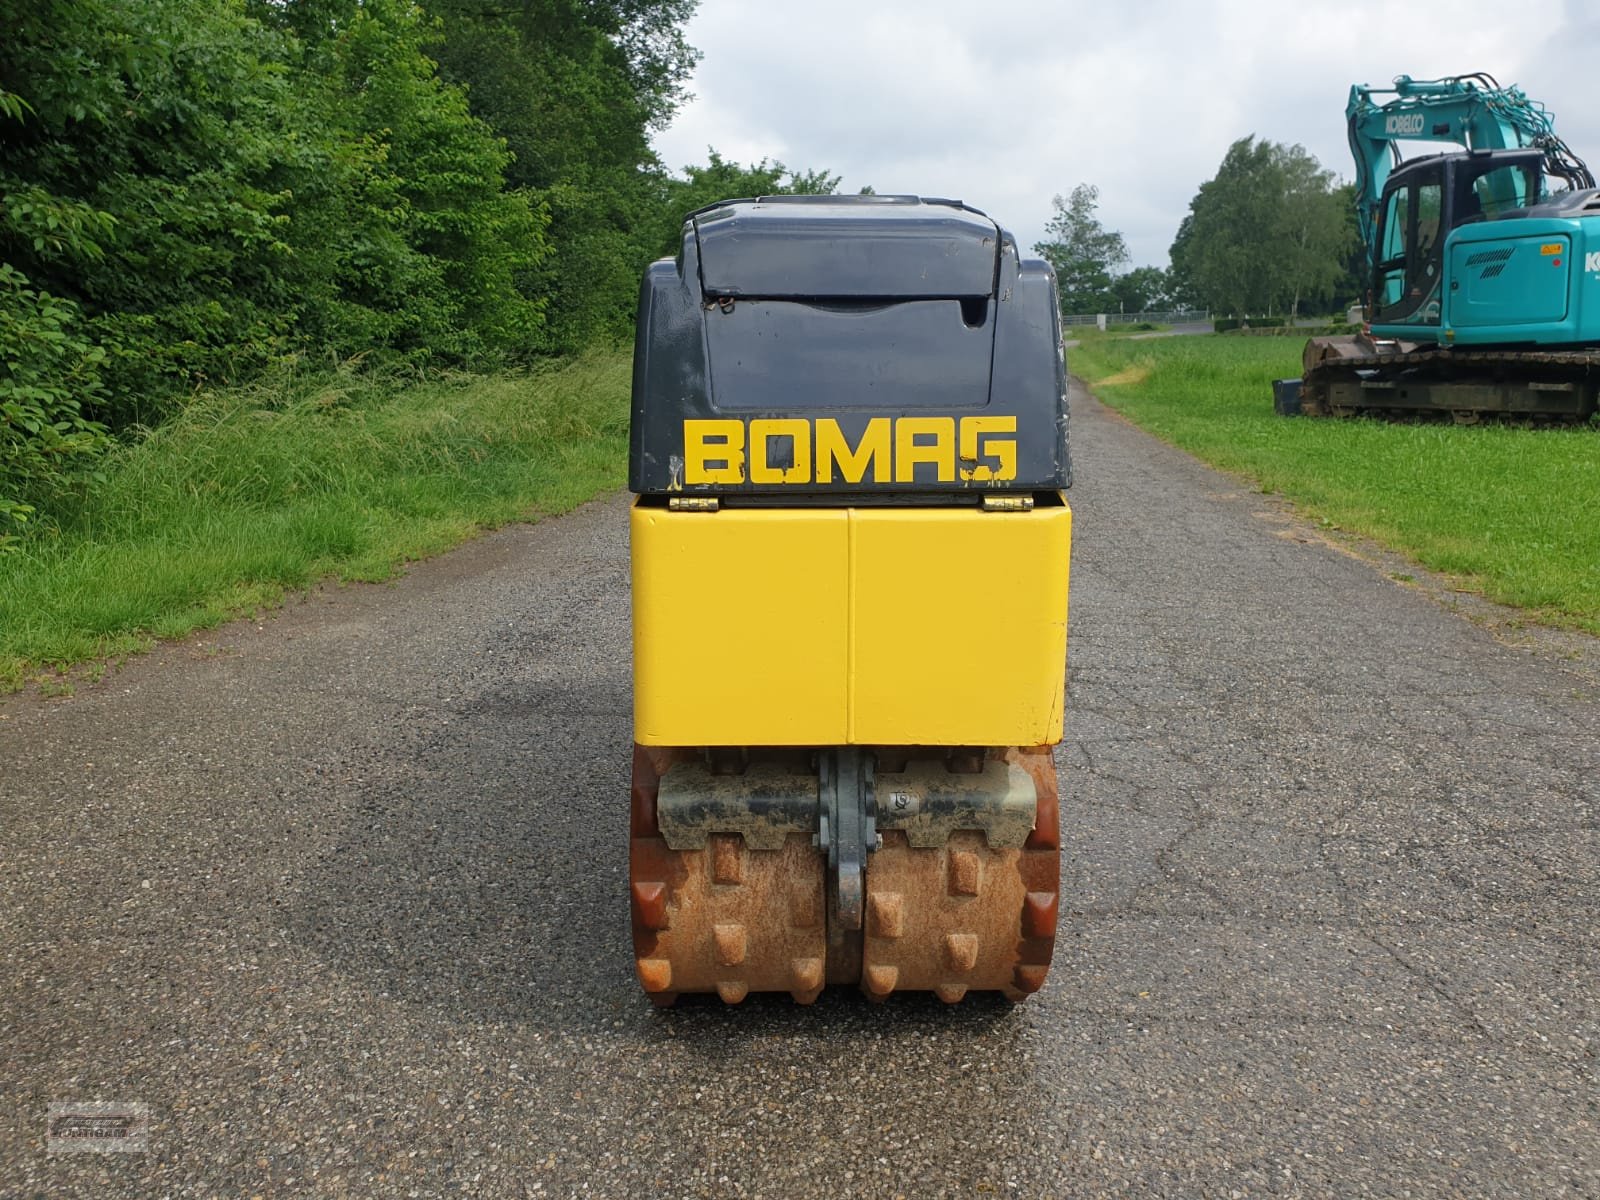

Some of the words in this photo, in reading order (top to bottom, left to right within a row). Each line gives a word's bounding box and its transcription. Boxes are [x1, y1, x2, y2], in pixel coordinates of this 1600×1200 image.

[1385, 113, 1424, 133] KOBELCO
[1585, 251, 1600, 272] K
[684, 416, 1016, 484] BOMAG
